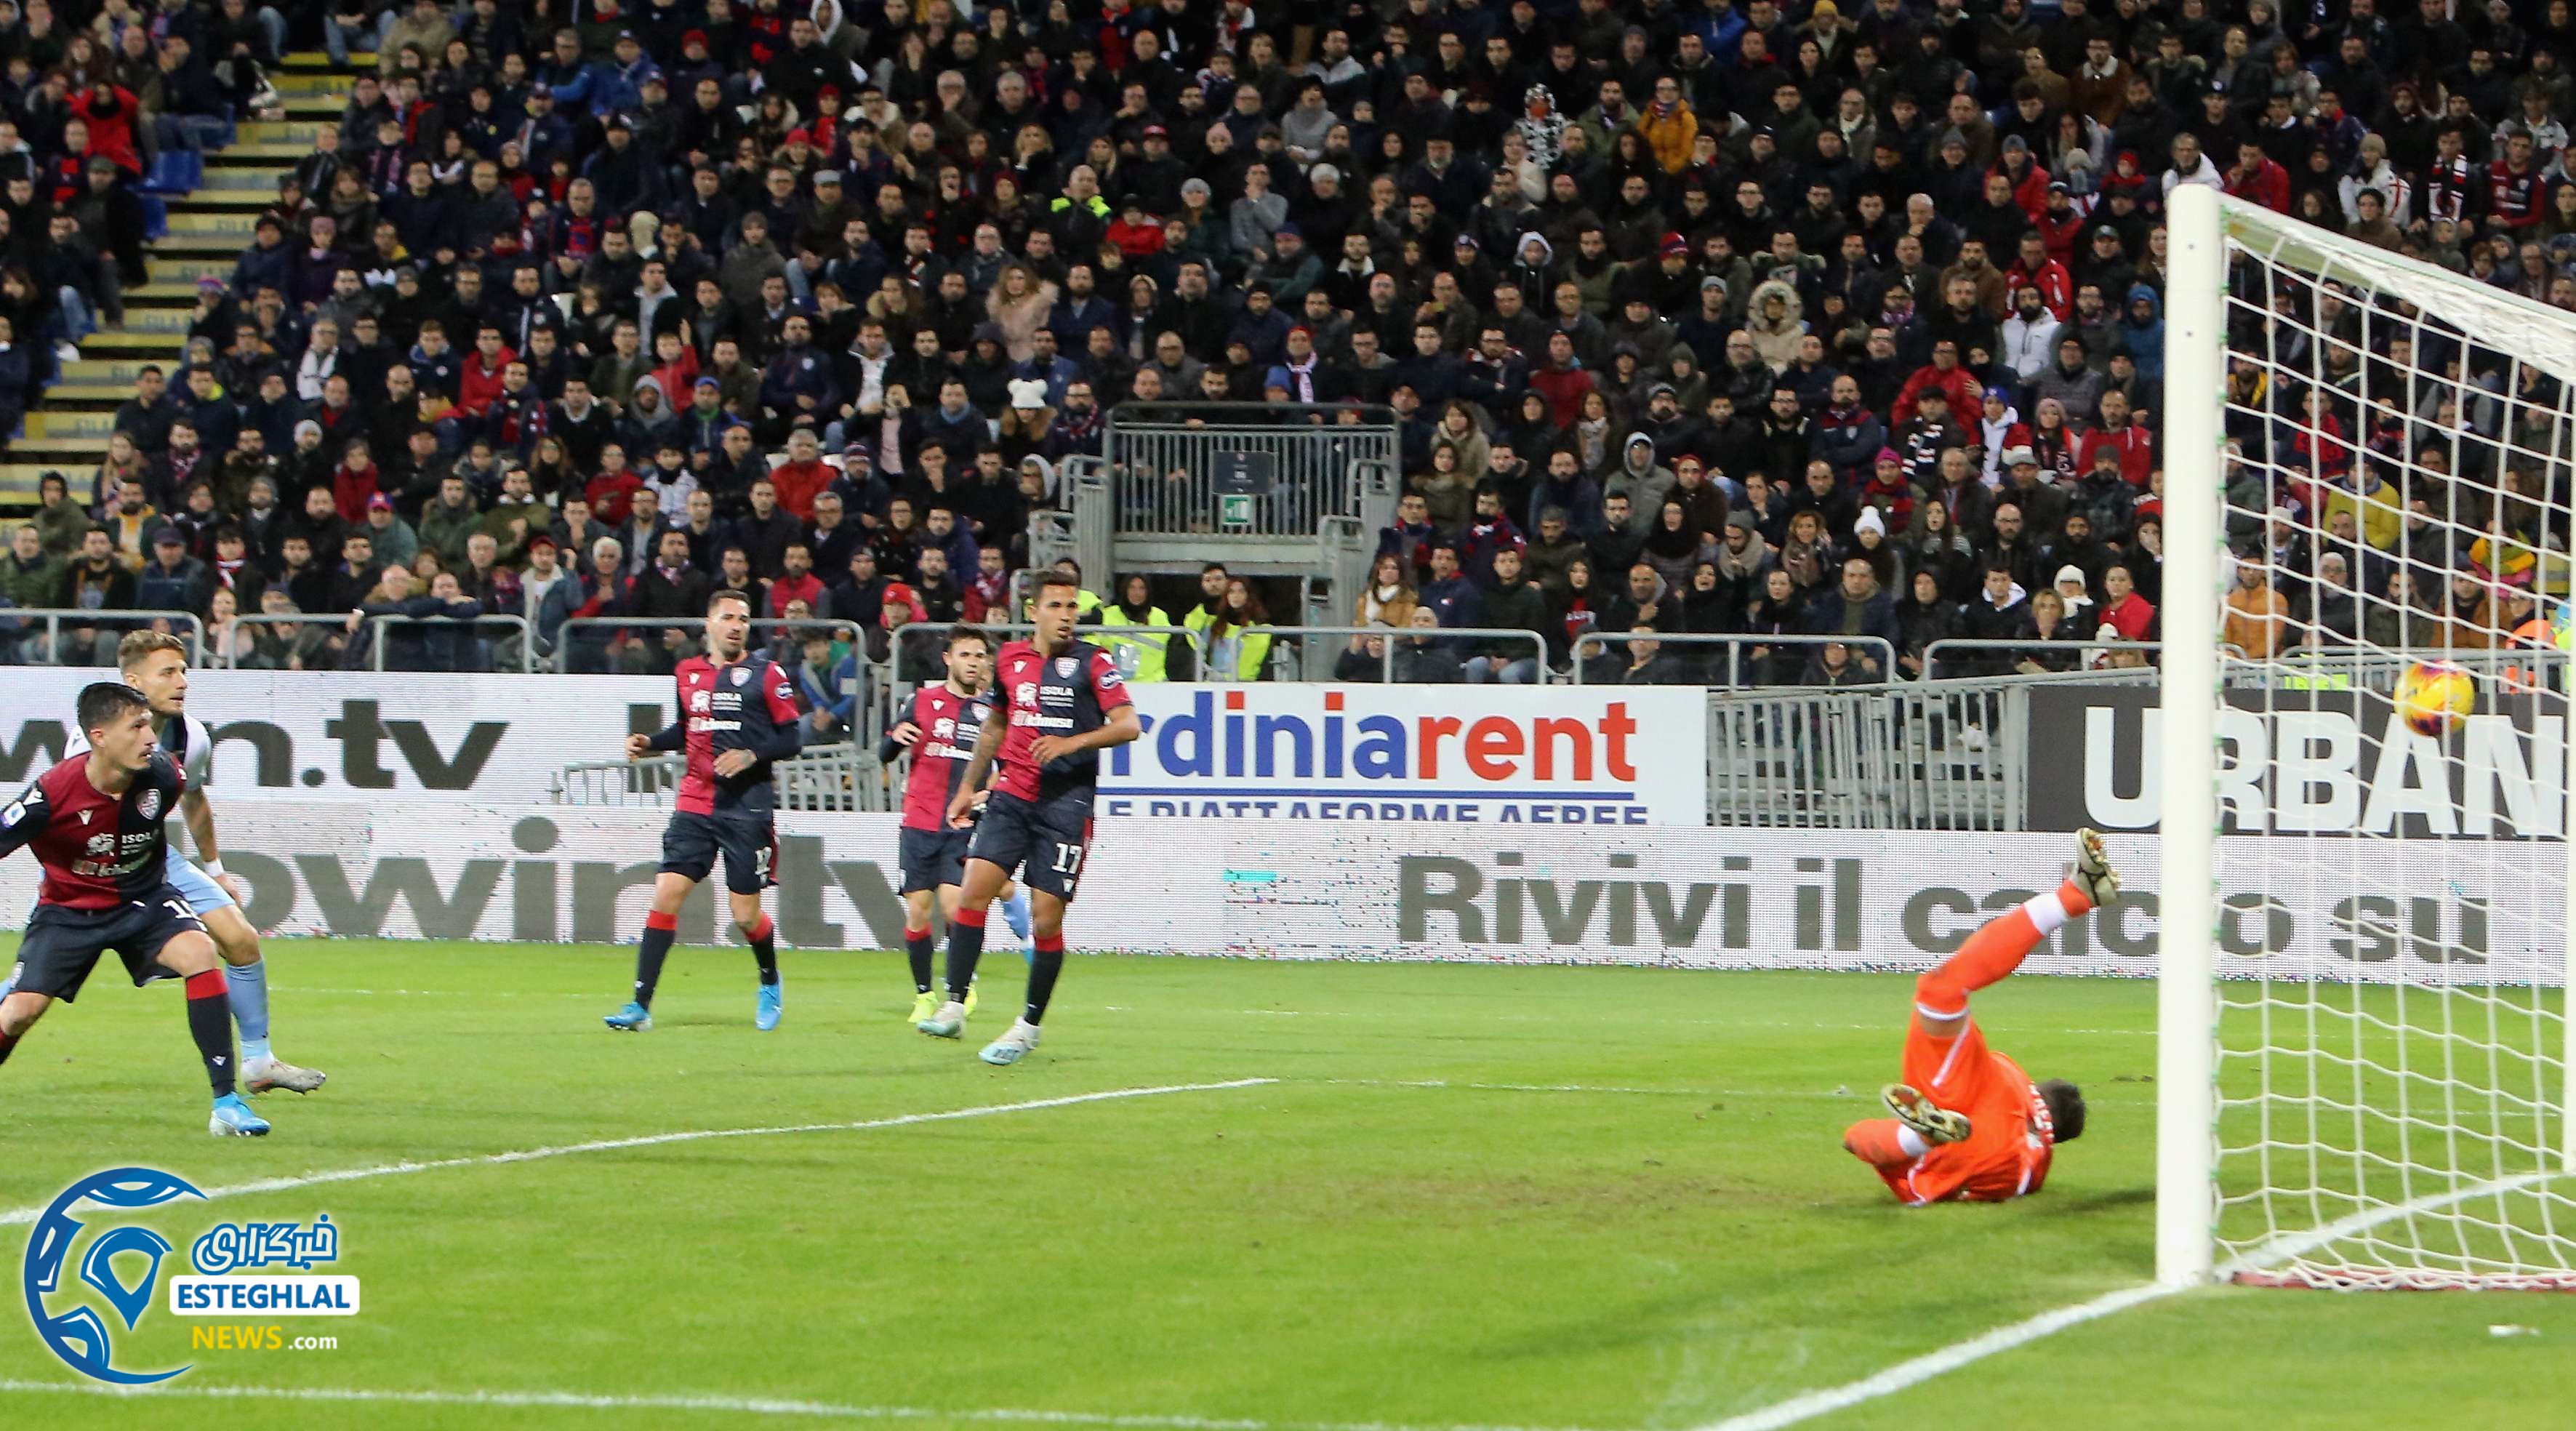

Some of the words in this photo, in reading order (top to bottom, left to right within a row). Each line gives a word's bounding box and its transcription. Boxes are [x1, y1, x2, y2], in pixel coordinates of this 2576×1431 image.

[0, 700, 508, 790] wn.tv
[1111, 691, 1637, 781] rdiniarent
[1051, 843, 1083, 874] 17
[1399, 854, 1750, 949] Rivivi
[1796, 857, 1861, 951] il
[1902, 859, 2295, 957] clco
[2330, 894, 2489, 963] su
